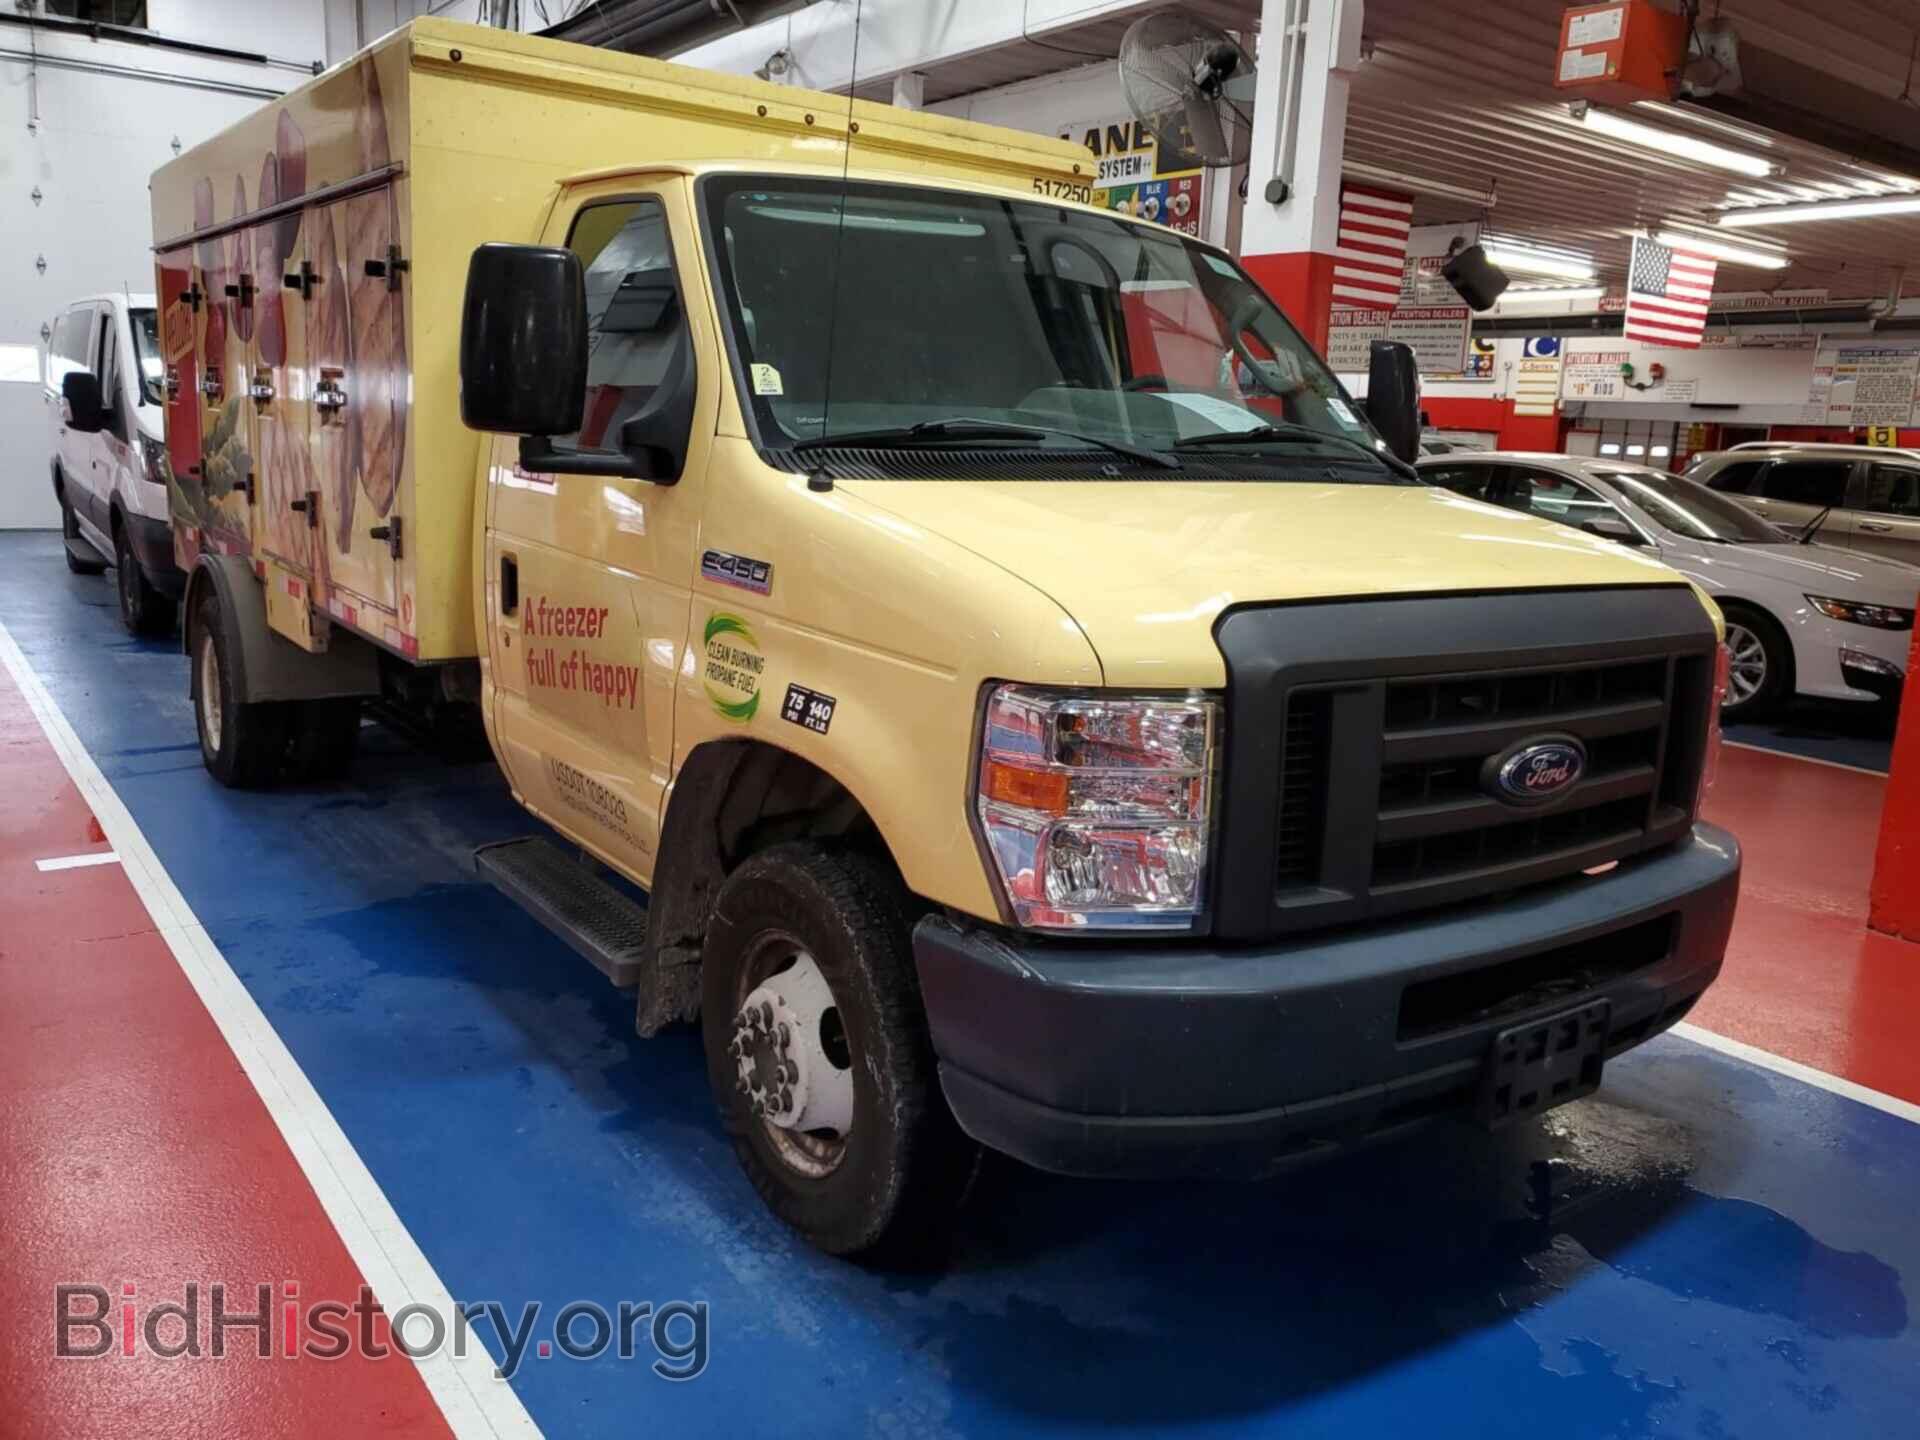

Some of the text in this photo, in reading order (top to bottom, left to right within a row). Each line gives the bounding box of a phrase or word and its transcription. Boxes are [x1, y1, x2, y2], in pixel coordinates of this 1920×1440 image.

[1061, 120, 1153, 156] ANE
[1099, 156, 1142, 180] SYSTEM
[1033, 177, 1091, 204] 517250
[1527, 337, 1557, 357] C
[524, 596, 608, 639] A freezer
[708, 640, 765, 675] CLEAN BURNING
[527, 648, 639, 710] full of happy
[705, 661, 756, 694] PROPANE FUEL
[788, 692, 806, 710] 75
[809, 701, 831, 721] 140
[1525, 752, 1570, 786] Ford
